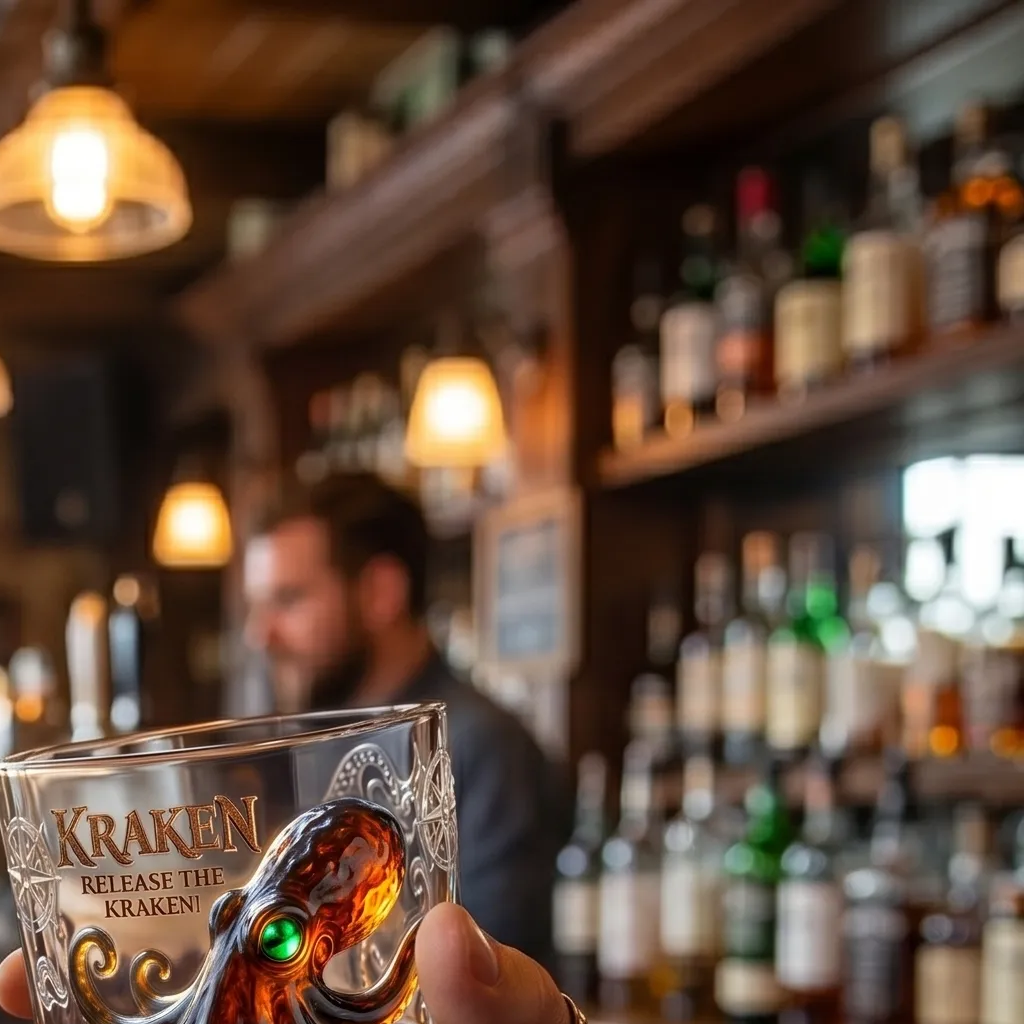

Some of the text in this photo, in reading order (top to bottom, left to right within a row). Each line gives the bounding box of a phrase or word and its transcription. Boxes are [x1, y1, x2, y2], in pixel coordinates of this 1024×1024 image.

[51, 795, 261, 868] KRAKEN
[81, 867, 225, 895] RELEASE THE
